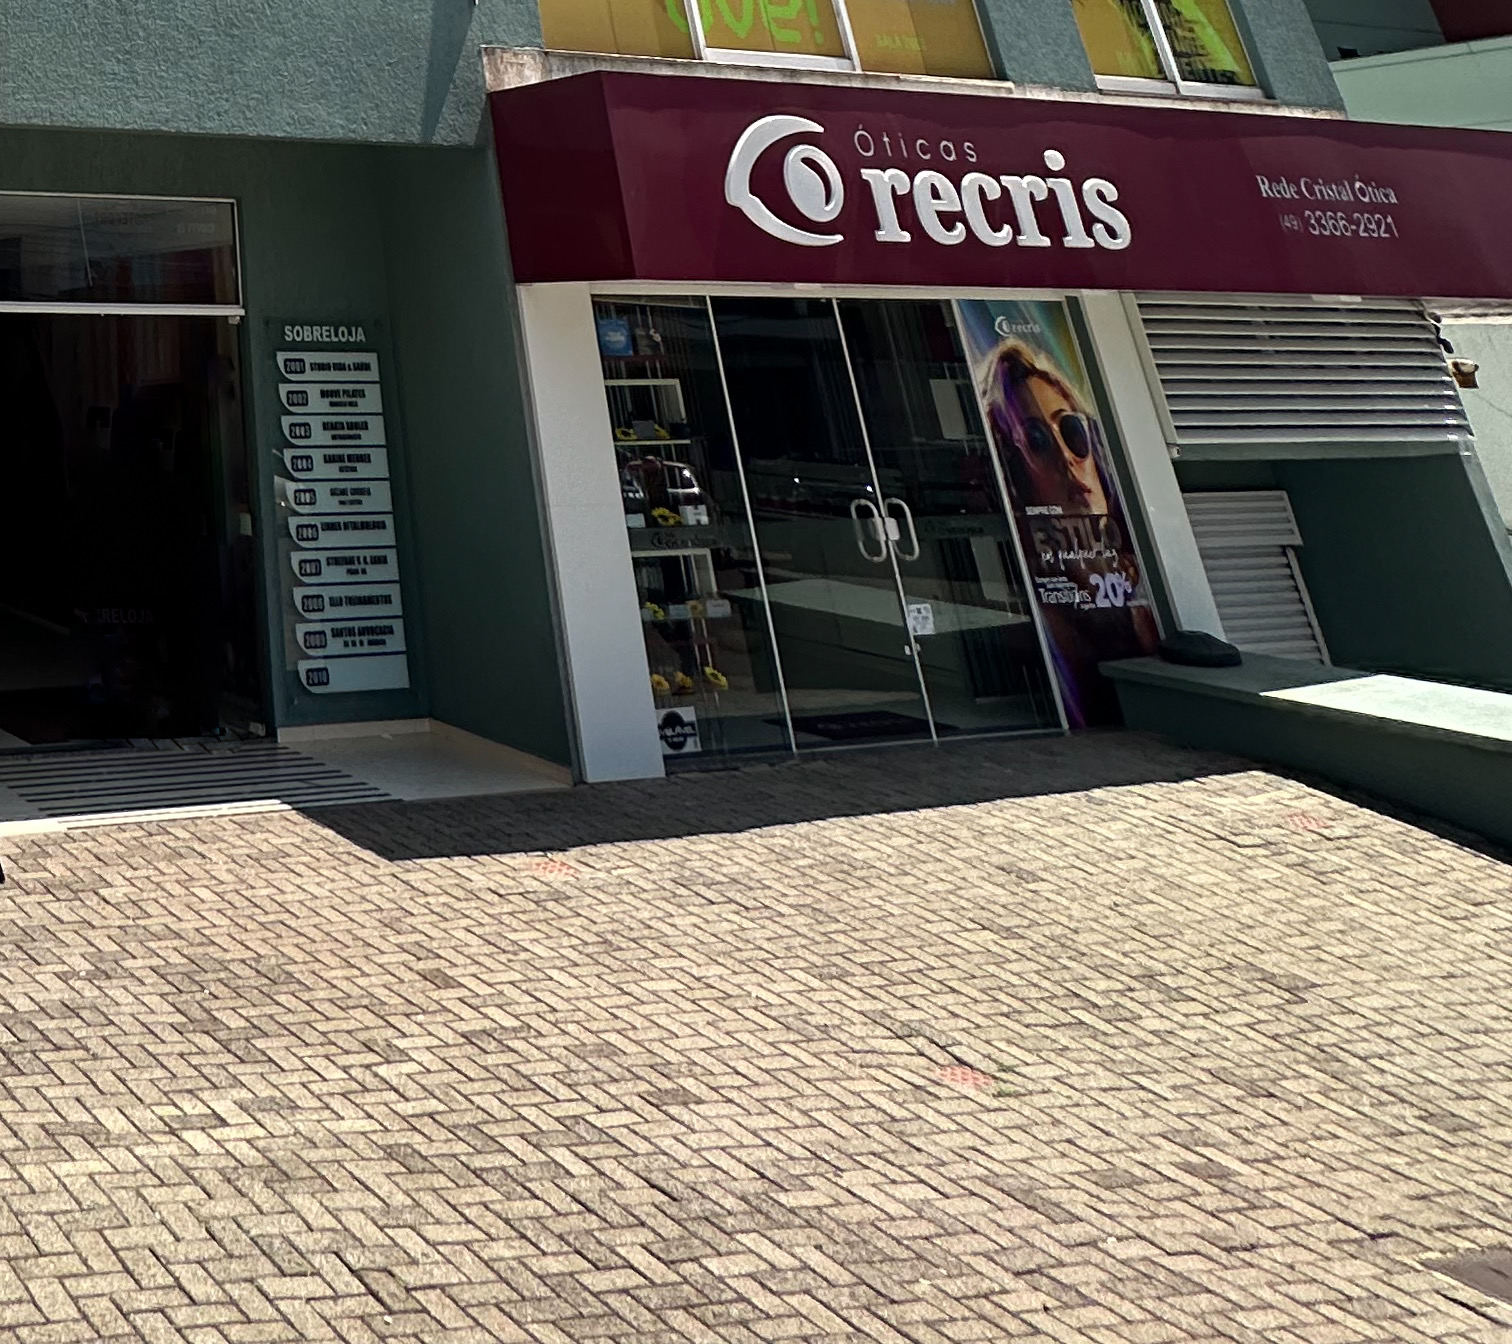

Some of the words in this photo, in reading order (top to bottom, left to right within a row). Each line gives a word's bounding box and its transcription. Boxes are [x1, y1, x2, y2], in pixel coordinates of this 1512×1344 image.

[853, 124, 977, 163] Óticas
[860, 148, 1132, 250] recris
[1255, 175, 1298, 199] Rede
[1301, 178, 1354, 201] Cristal
[1355, 173, 1399, 204] Ótica
[1280, 214, 1303, 233] (49)
[1304, 210, 1399, 239] 3366-2921
[284, 325, 366, 342] SOBRELOJA
[286, 360, 304, 372] 2001
[288, 393, 306, 404] 2002
[308, 670, 327, 684] 2010
